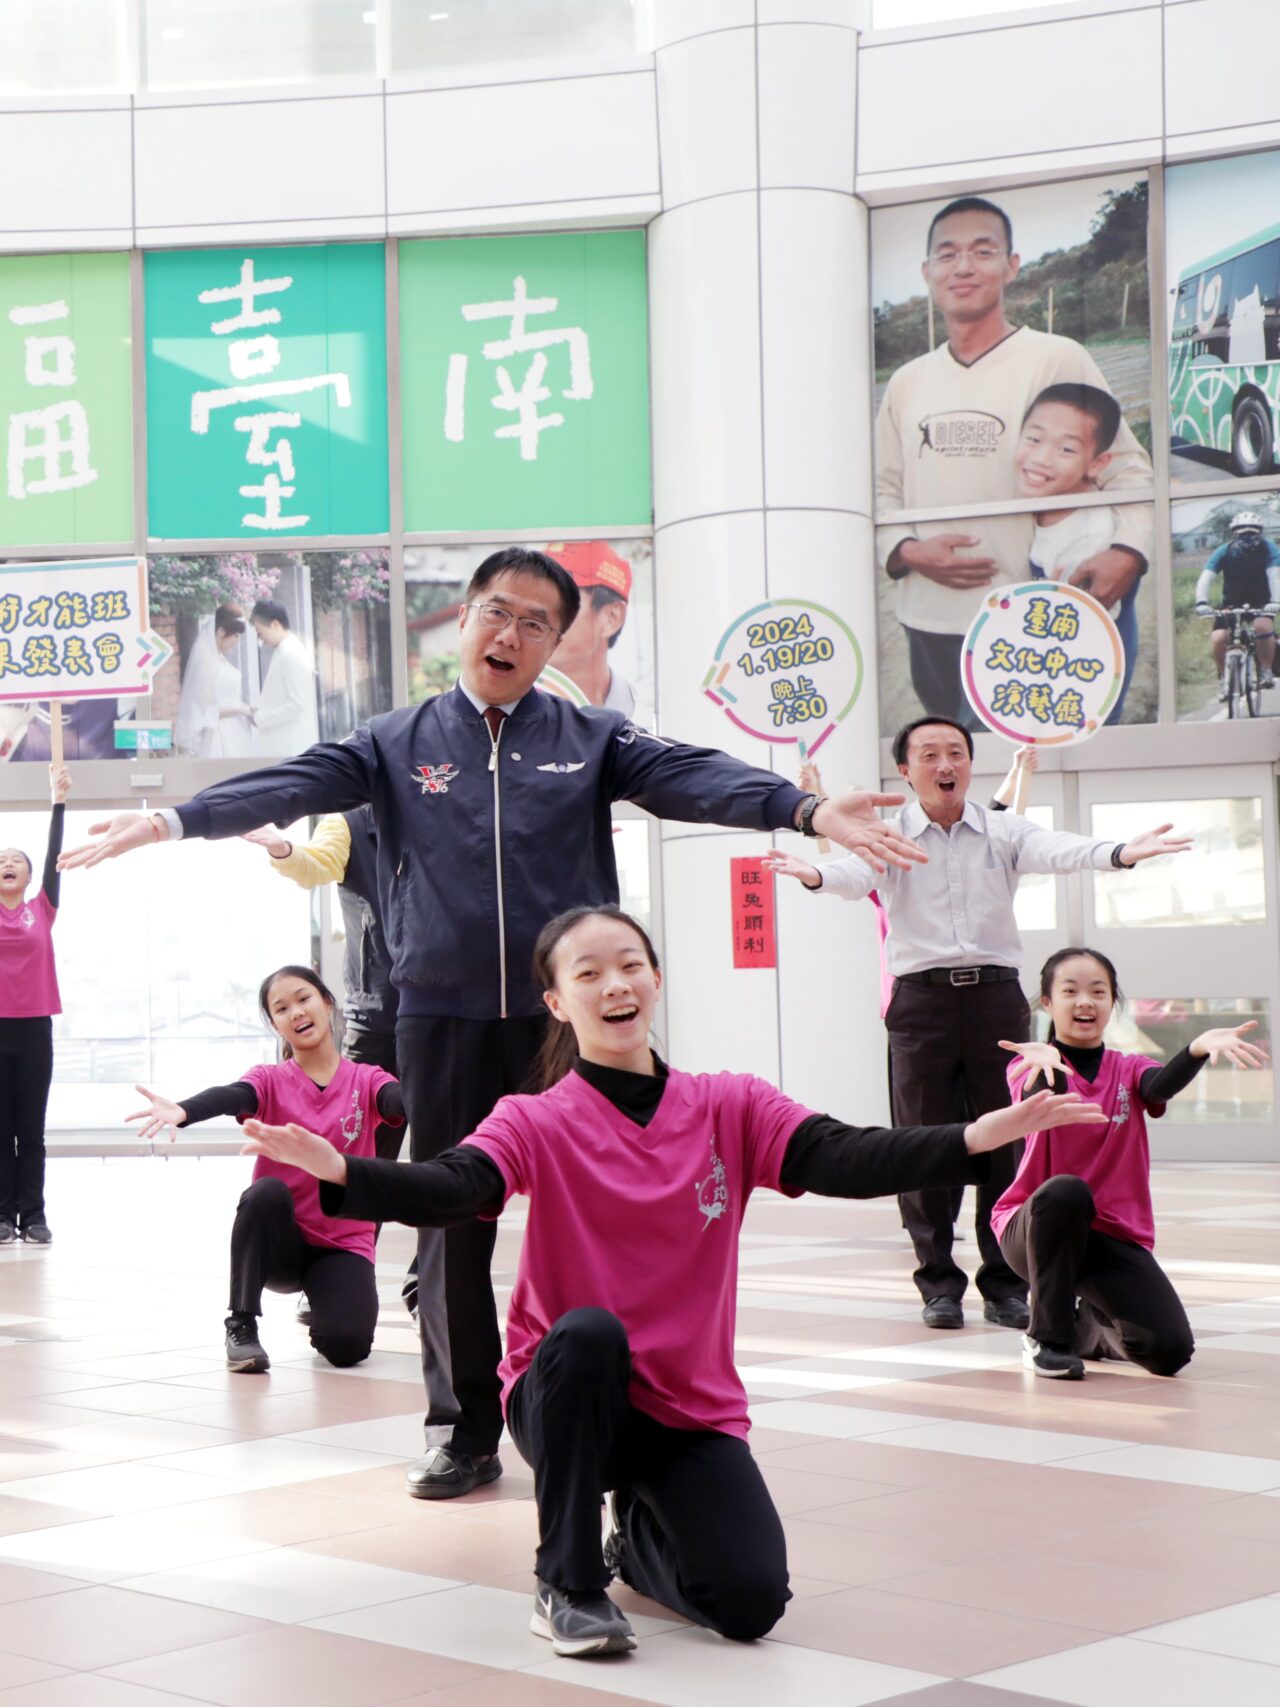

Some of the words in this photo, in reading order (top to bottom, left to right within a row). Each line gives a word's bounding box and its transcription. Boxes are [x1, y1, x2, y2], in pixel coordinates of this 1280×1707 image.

[935, 421, 998, 445] DIESEL
[747, 613, 814, 648] 2024
[1023, 597, 1080, 641] 臺南
[737, 637, 834, 677] 1.19/20
[985, 638, 1104, 682] 文化中心
[771, 675, 816, 700] 晚上
[991, 680, 1085, 728] 演藝廳
[768, 695, 827, 727] 7:30
